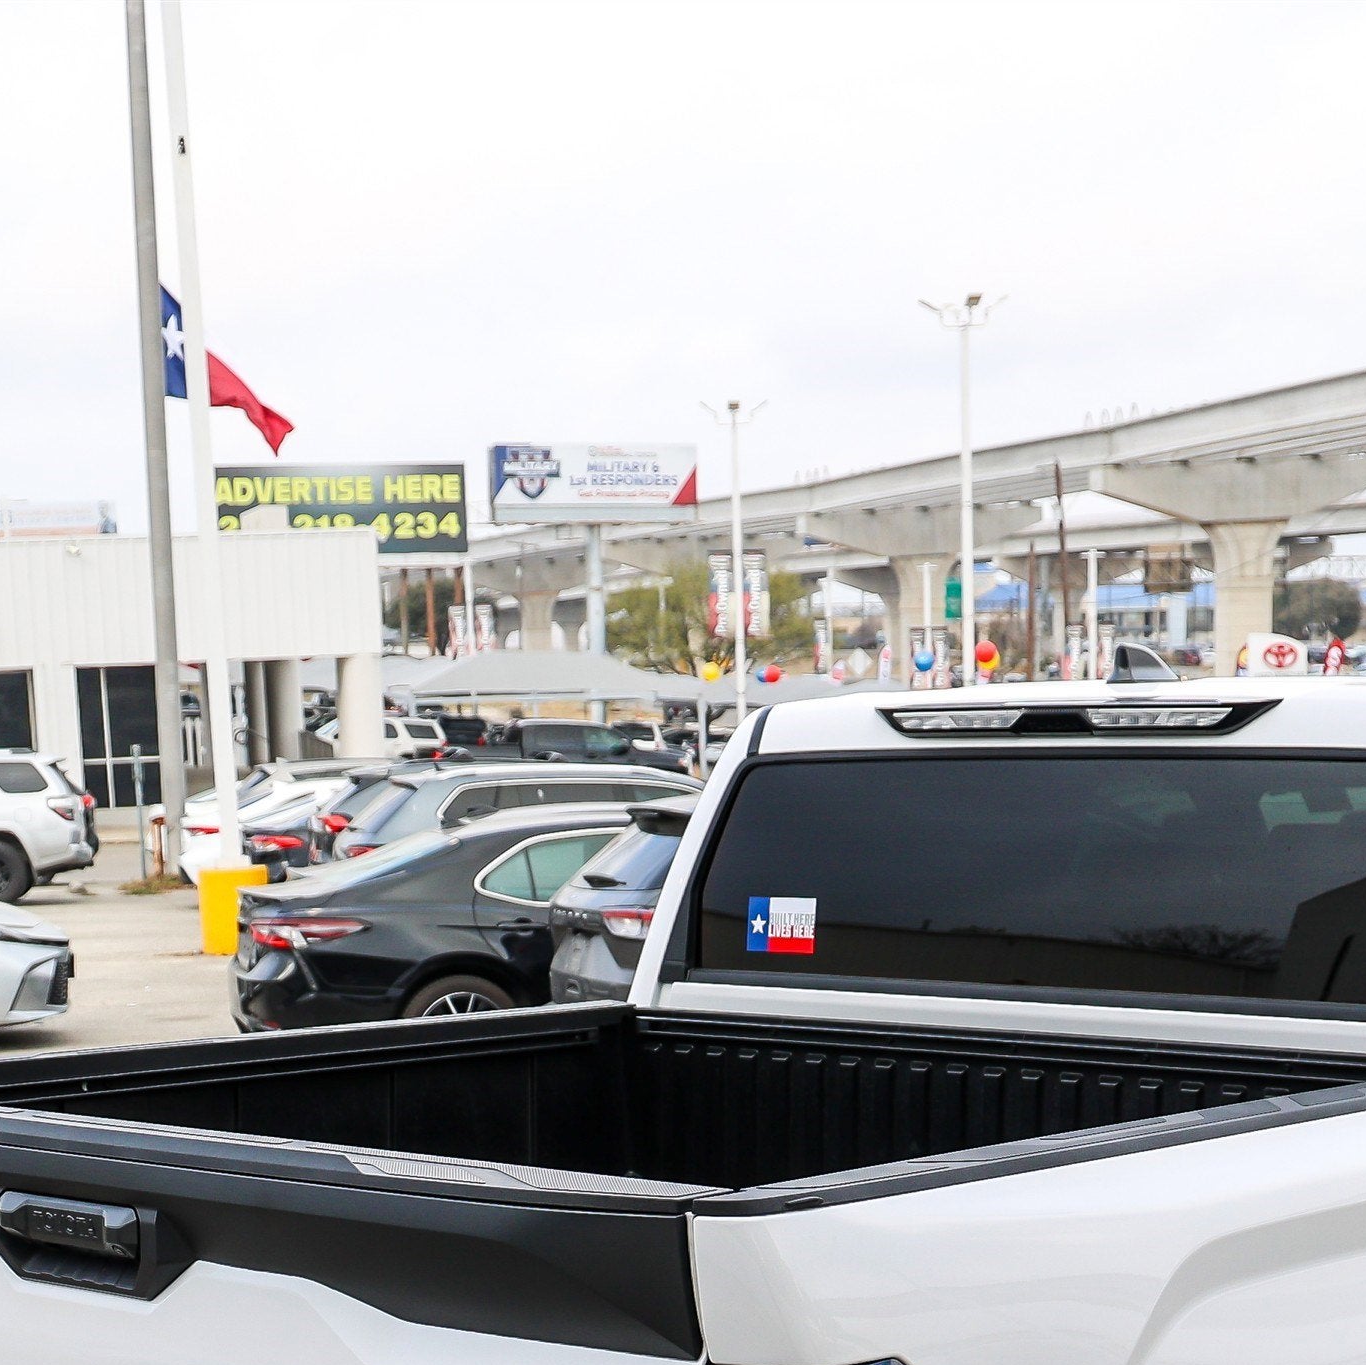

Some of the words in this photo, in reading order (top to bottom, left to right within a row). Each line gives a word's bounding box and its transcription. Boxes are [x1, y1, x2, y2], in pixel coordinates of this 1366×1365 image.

[587, 461, 648, 473] MILITARY
[591, 474, 678, 486] RESPONDERS
[215, 476, 373, 505] ADVERTISE
[384, 474, 462, 504] HERE
[770, 913, 793, 926] BUILT
[794, 914, 815, 926] HERE
[768, 925, 792, 938] LIVES
[793, 925, 815, 938] HERE
